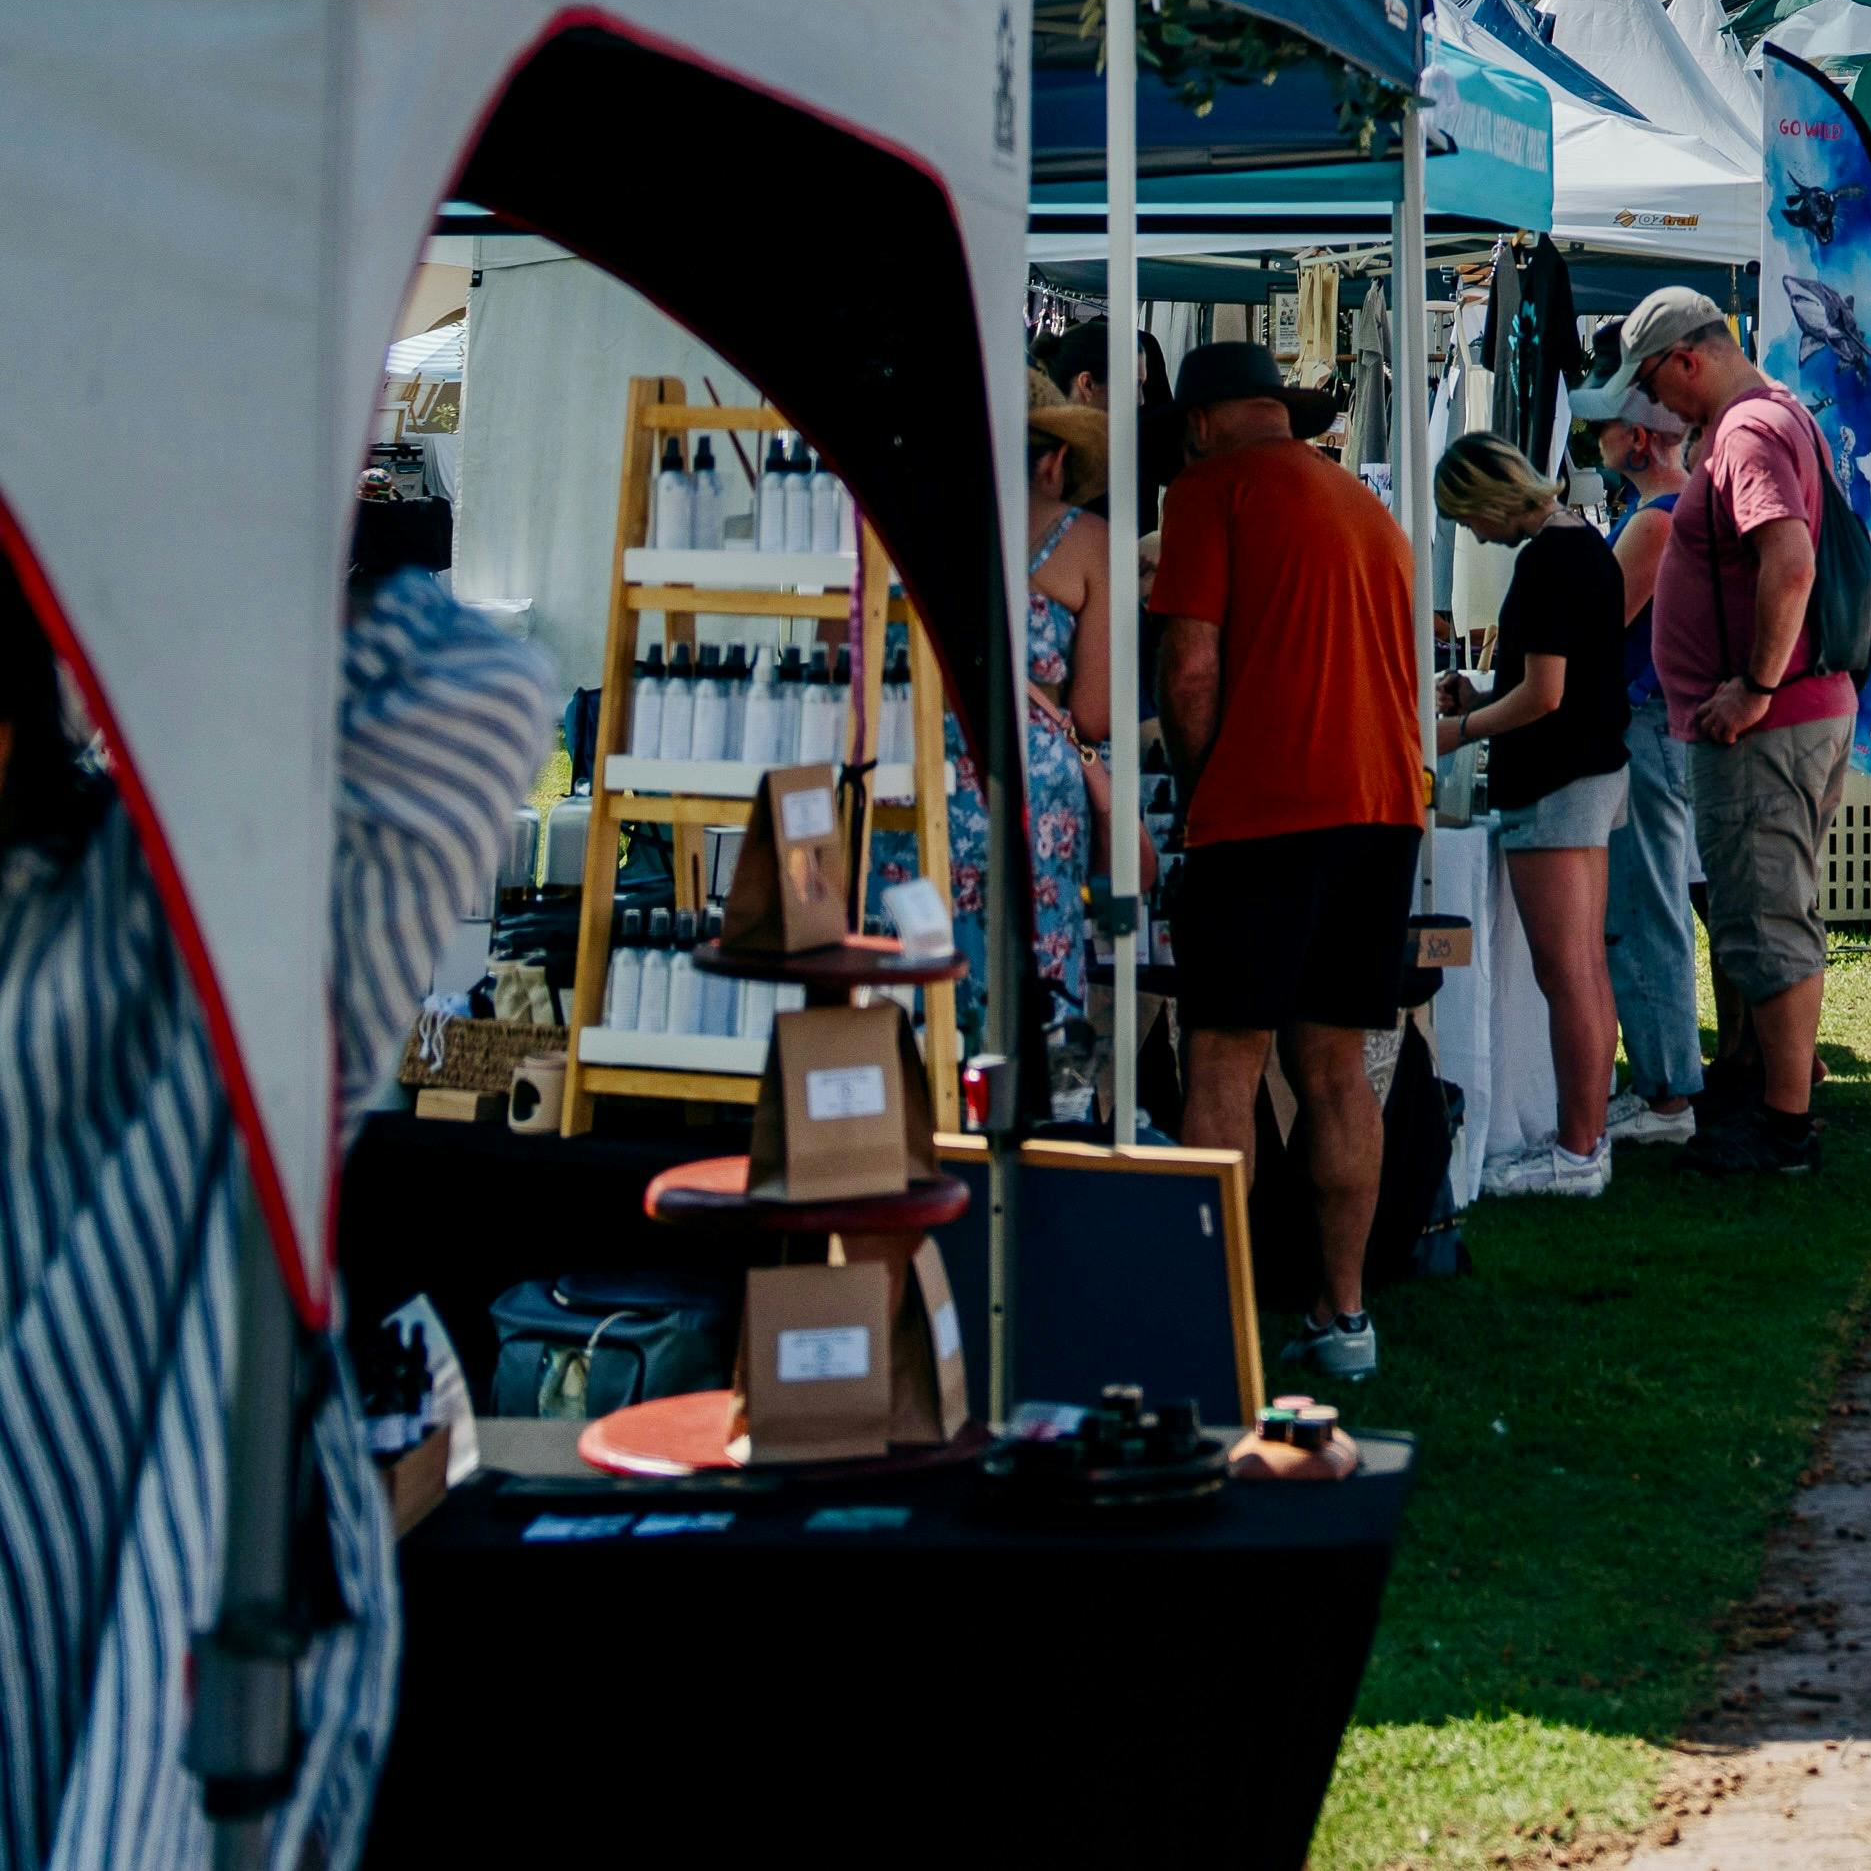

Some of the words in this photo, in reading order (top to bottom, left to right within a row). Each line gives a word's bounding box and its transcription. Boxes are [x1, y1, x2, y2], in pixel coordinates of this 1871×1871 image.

[1779, 118, 1801, 136] GO
[1804, 120, 1842, 141] WILD
[1639, 213, 1699, 226] OZtrail
